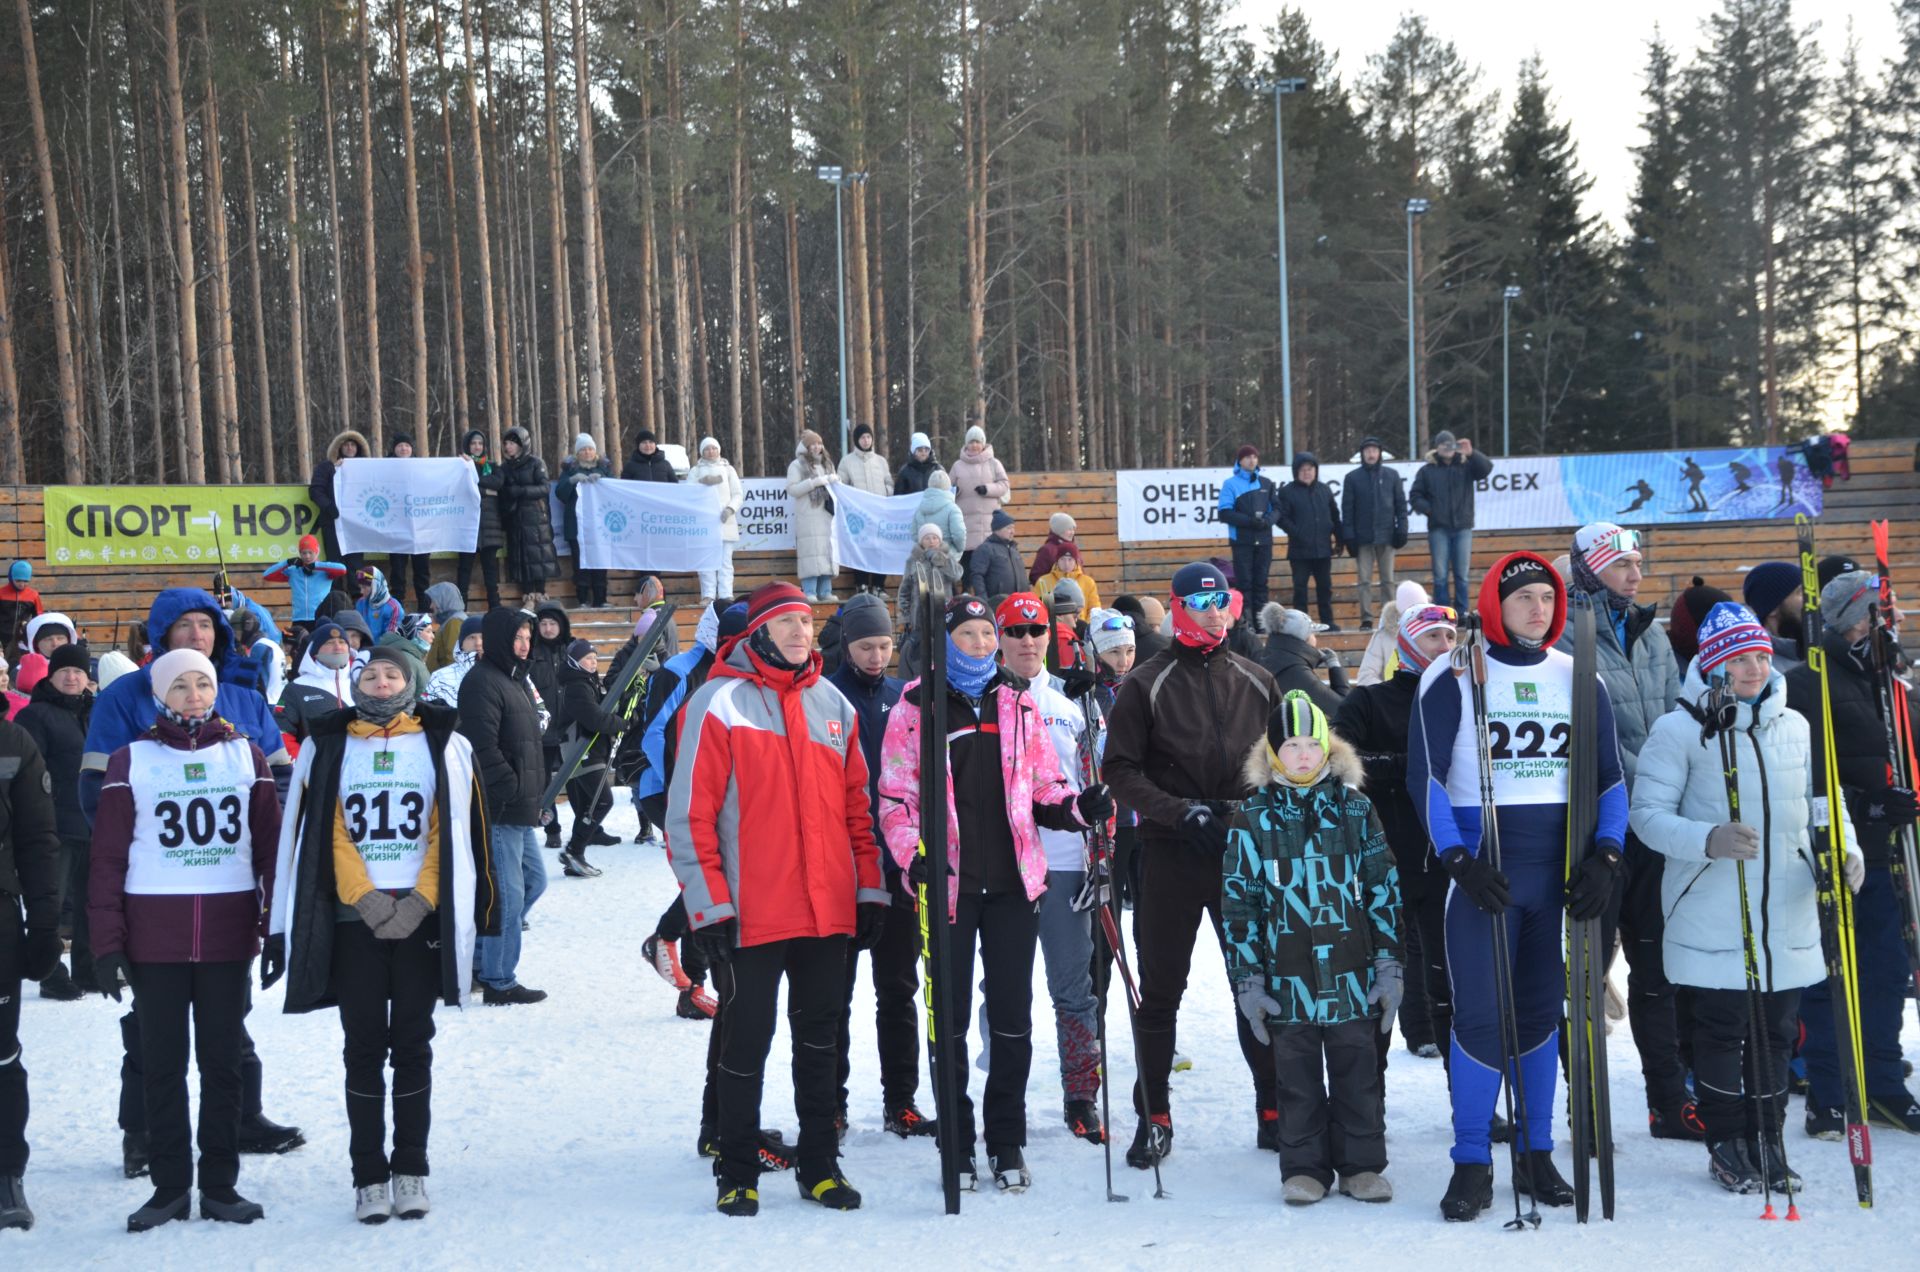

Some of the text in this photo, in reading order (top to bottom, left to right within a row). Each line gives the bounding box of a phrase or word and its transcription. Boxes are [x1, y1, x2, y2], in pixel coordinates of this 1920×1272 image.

[1476, 472, 1540, 492] ВСЕХ
[404, 494, 455, 507] Сетевая
[745, 489, 788, 501] АЧНИ
[404, 505, 464, 518] Компания
[641, 511, 697, 525] Сетевая
[740, 506, 788, 520] ОДНЯ,
[66, 504, 192, 537] СПОРТ
[233, 503, 322, 536] НОР
[641, 522, 708, 537] Компания
[747, 523, 788, 535] СЕБЯ!
[1500, 561, 1546, 583] LUKO
[1488, 720, 1571, 759] 222
[1514, 769, 1555, 778] ЖИЗНИ
[395, 782, 420, 790] РАЙОН
[158, 788, 209, 799] АГРЫЗСКИЙ
[154, 795, 242, 848] 303
[345, 790, 424, 843] 313
[384, 843, 418, 853] НОРМА
[183, 857, 221, 867] ЖИЗНИ
[365, 853, 401, 862] ЖИЗНИ
